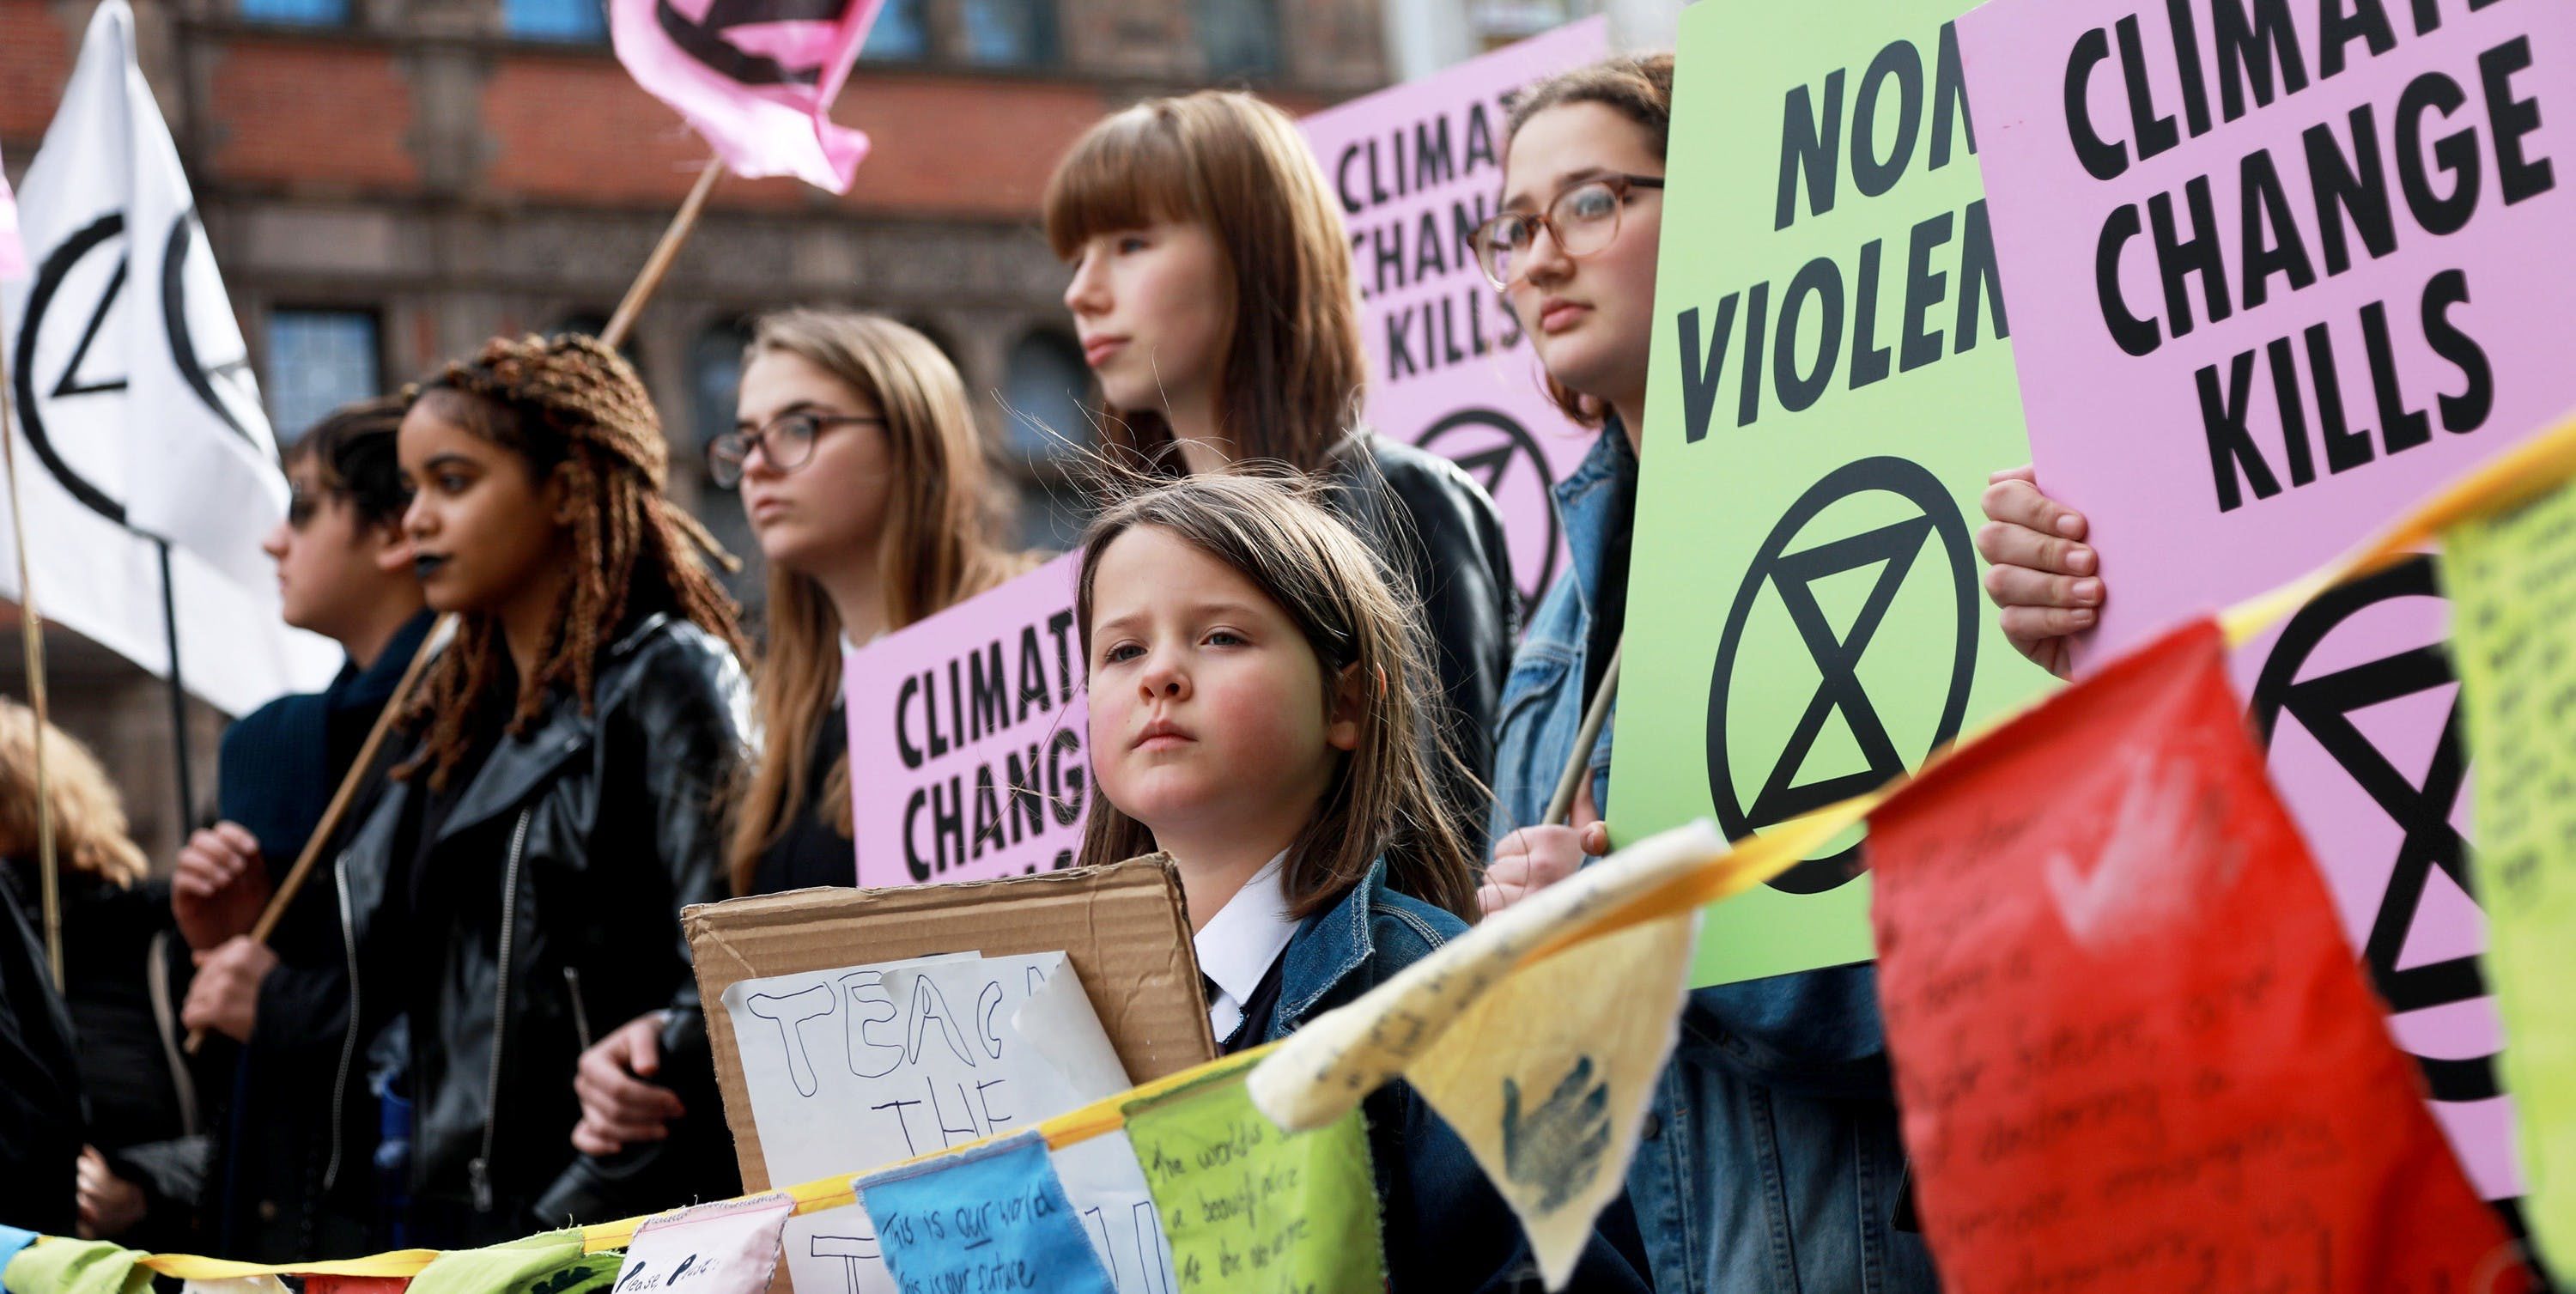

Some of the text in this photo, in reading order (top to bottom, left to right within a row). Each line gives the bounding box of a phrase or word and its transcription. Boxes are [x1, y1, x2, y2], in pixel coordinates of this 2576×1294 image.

[1337, 88, 1513, 215] CLIMA
[2063, 0, 2496, 181] CLIMA
[2095, 33, 2556, 357] CHANGE
[1385, 287, 1523, 382] KILLS
[2195, 269, 2495, 513] KILLS
[895, 607, 1087, 771] CLIMAT
[903, 720, 1089, 883] CHANG
[747, 967, 1046, 1097] TEAC
[871, 1076, 1012, 1157] THE
[882, 1211, 914, 1245] This
[923, 1209, 945, 1240] is
[955, 1200, 993, 1240] our
